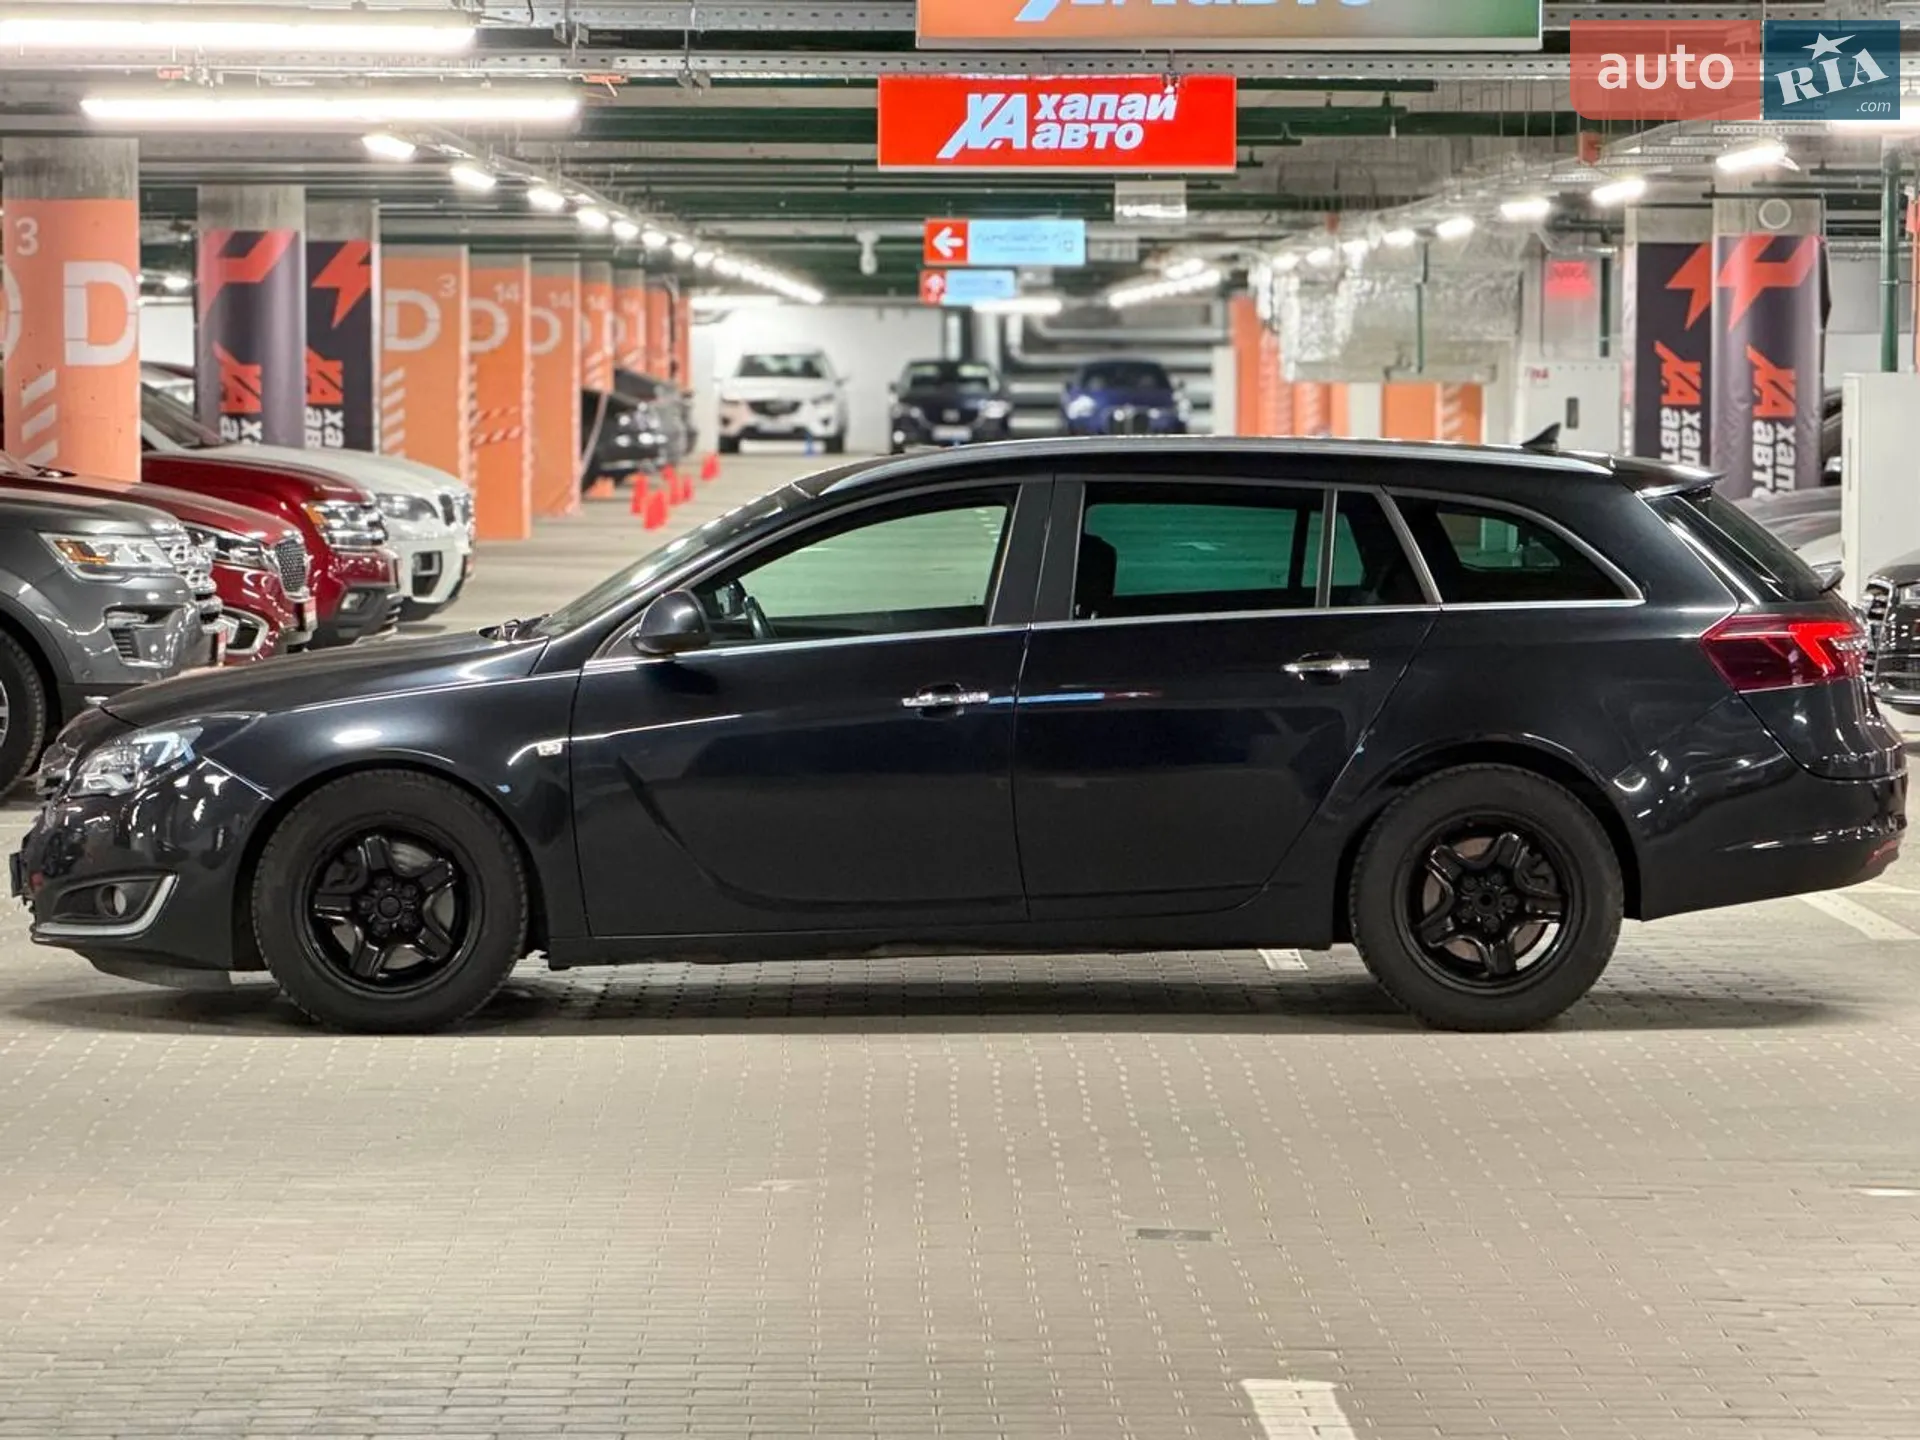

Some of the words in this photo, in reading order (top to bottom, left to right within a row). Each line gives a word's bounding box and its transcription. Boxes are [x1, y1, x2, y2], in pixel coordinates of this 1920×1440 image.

[1033, 87, 1178, 121] хапай
[1032, 123, 1144, 150] авто
[15, 217, 39, 256] 3
[64, 261, 138, 366] D
[385, 288, 441, 351] D
[437, 273, 457, 298] 3
[1660, 407, 1680, 463] авт
